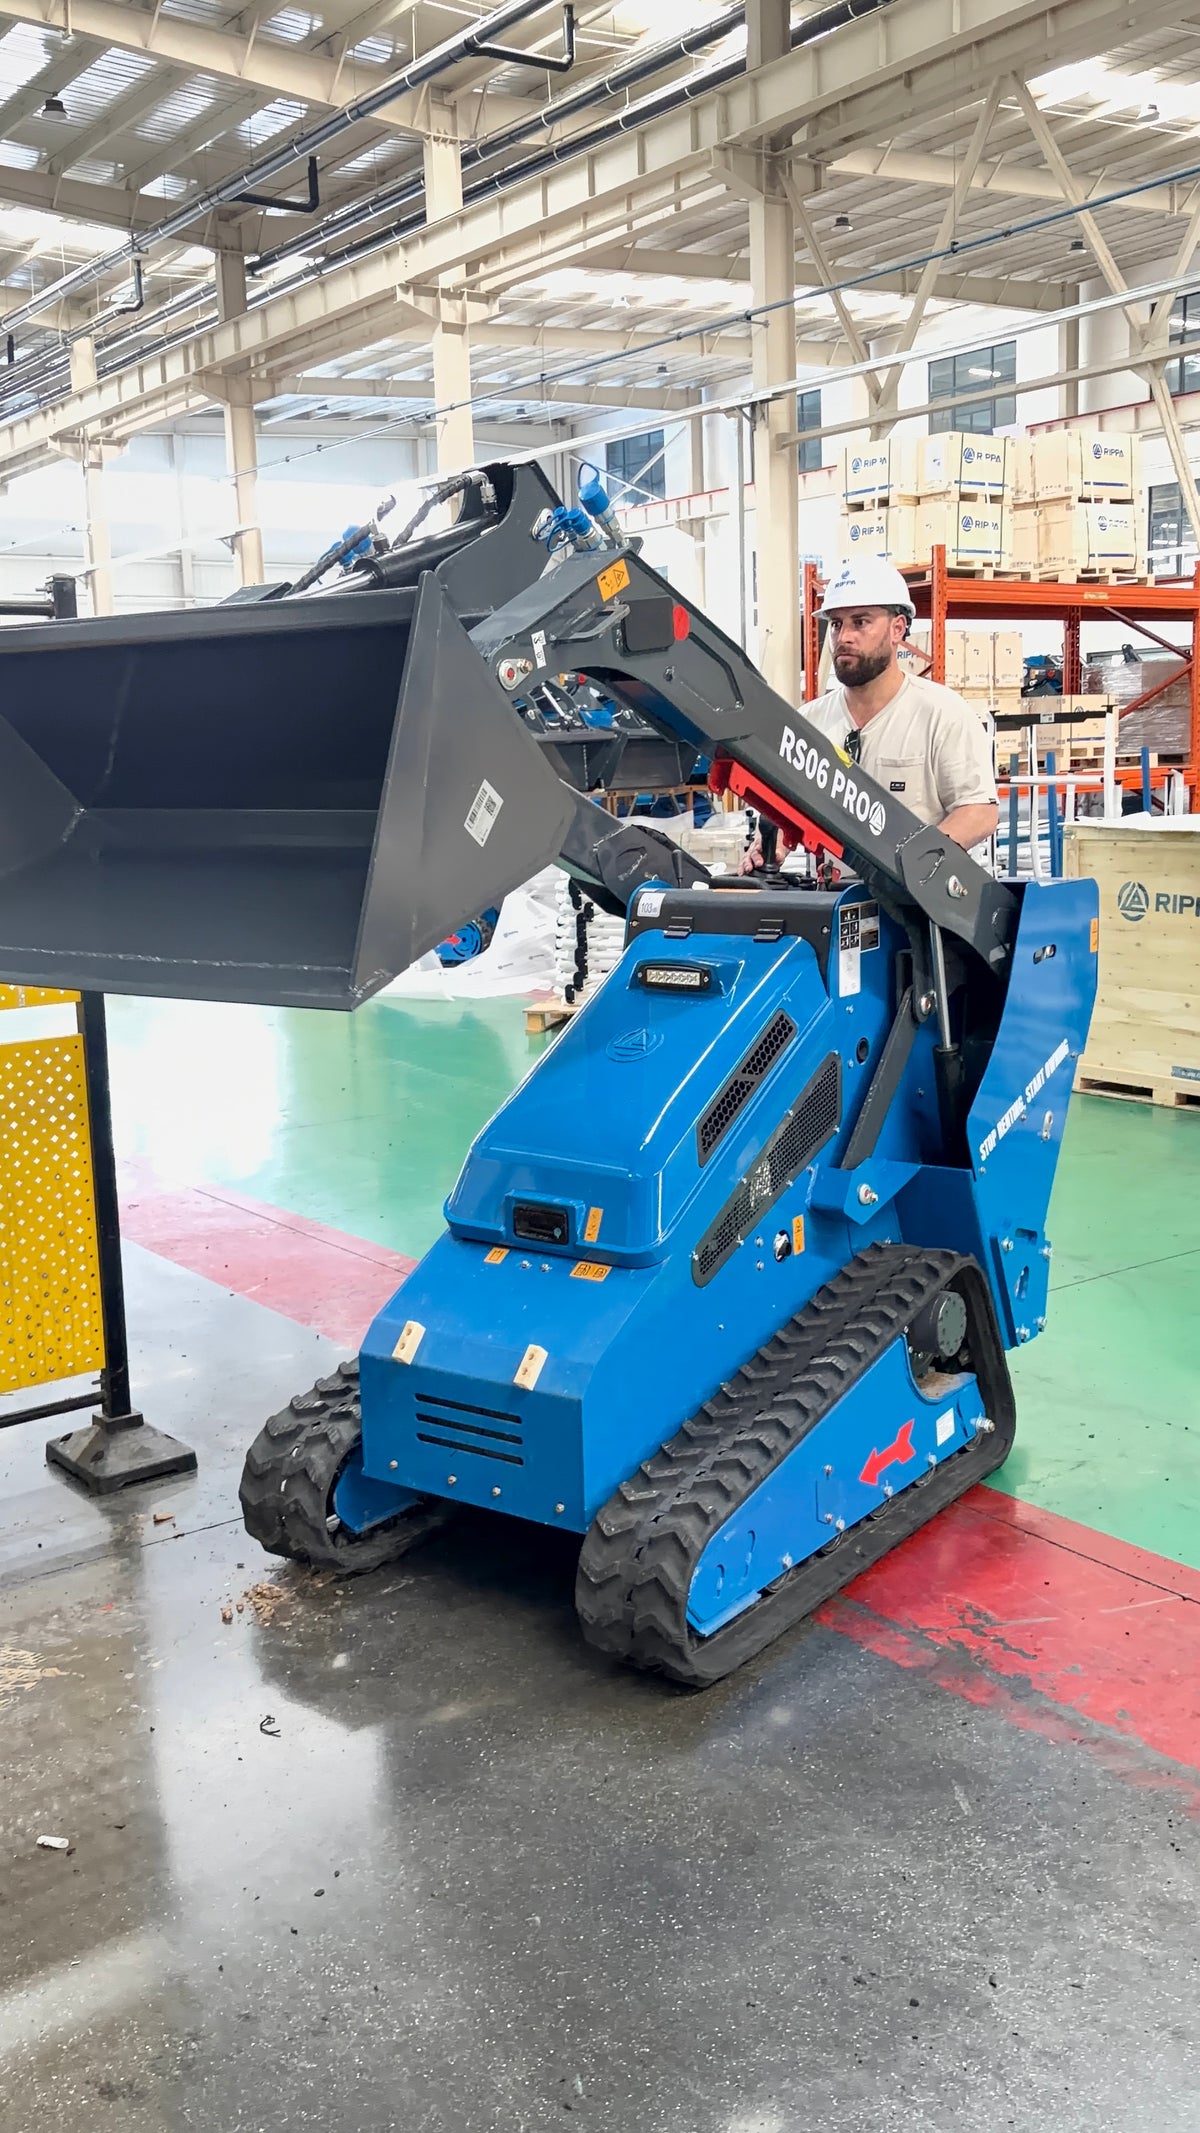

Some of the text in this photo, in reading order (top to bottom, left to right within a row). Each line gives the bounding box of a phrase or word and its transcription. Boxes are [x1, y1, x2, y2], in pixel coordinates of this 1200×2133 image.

[976, 451, 1001, 463] RPPA
[779, 725, 870, 822] RS06 PRO
[979, 1128, 997, 1162] STOP
[1025, 1067, 1045, 1104] START
